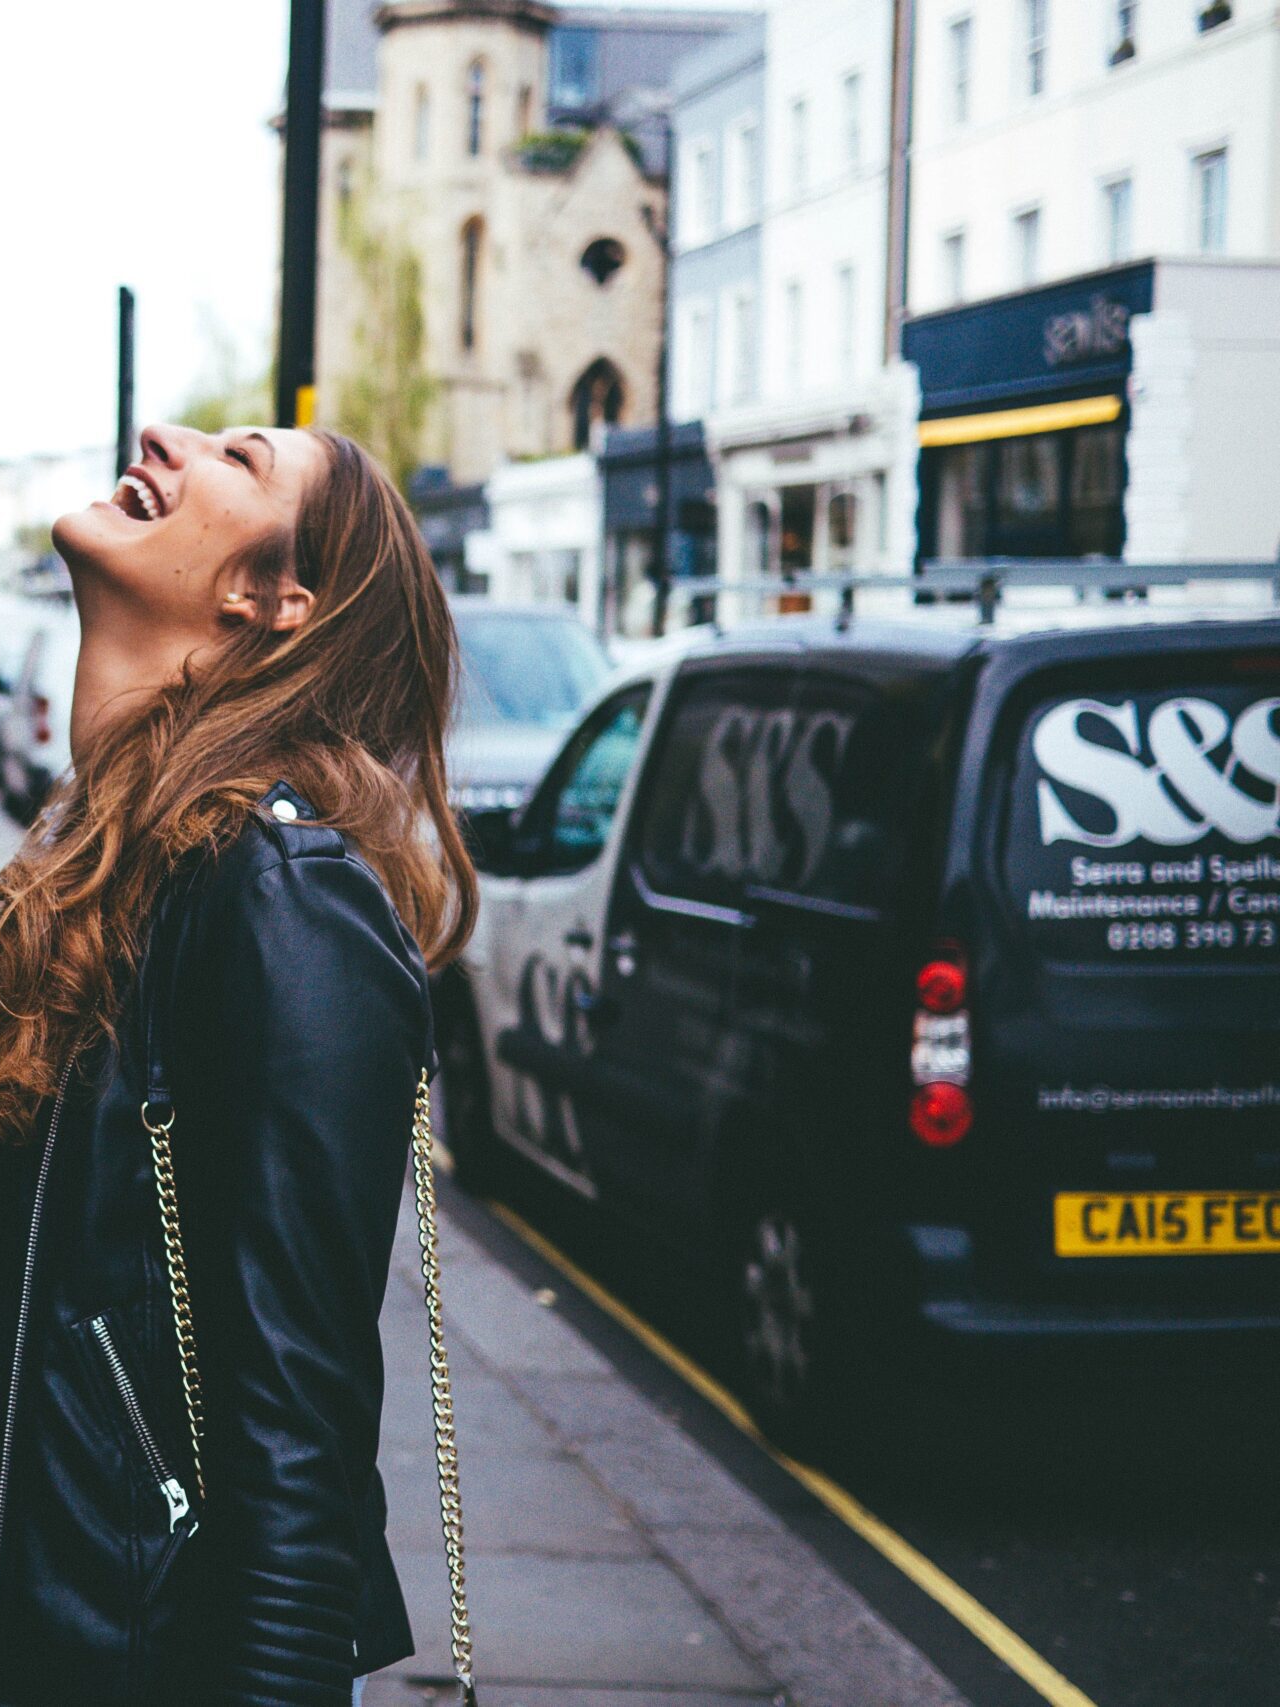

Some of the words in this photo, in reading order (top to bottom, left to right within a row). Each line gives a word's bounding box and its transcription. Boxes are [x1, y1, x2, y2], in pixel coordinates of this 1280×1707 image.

[1072, 855, 1144, 885] Serra
[1151, 854, 1203, 883] and
[1028, 889, 1200, 919] Maintenance
